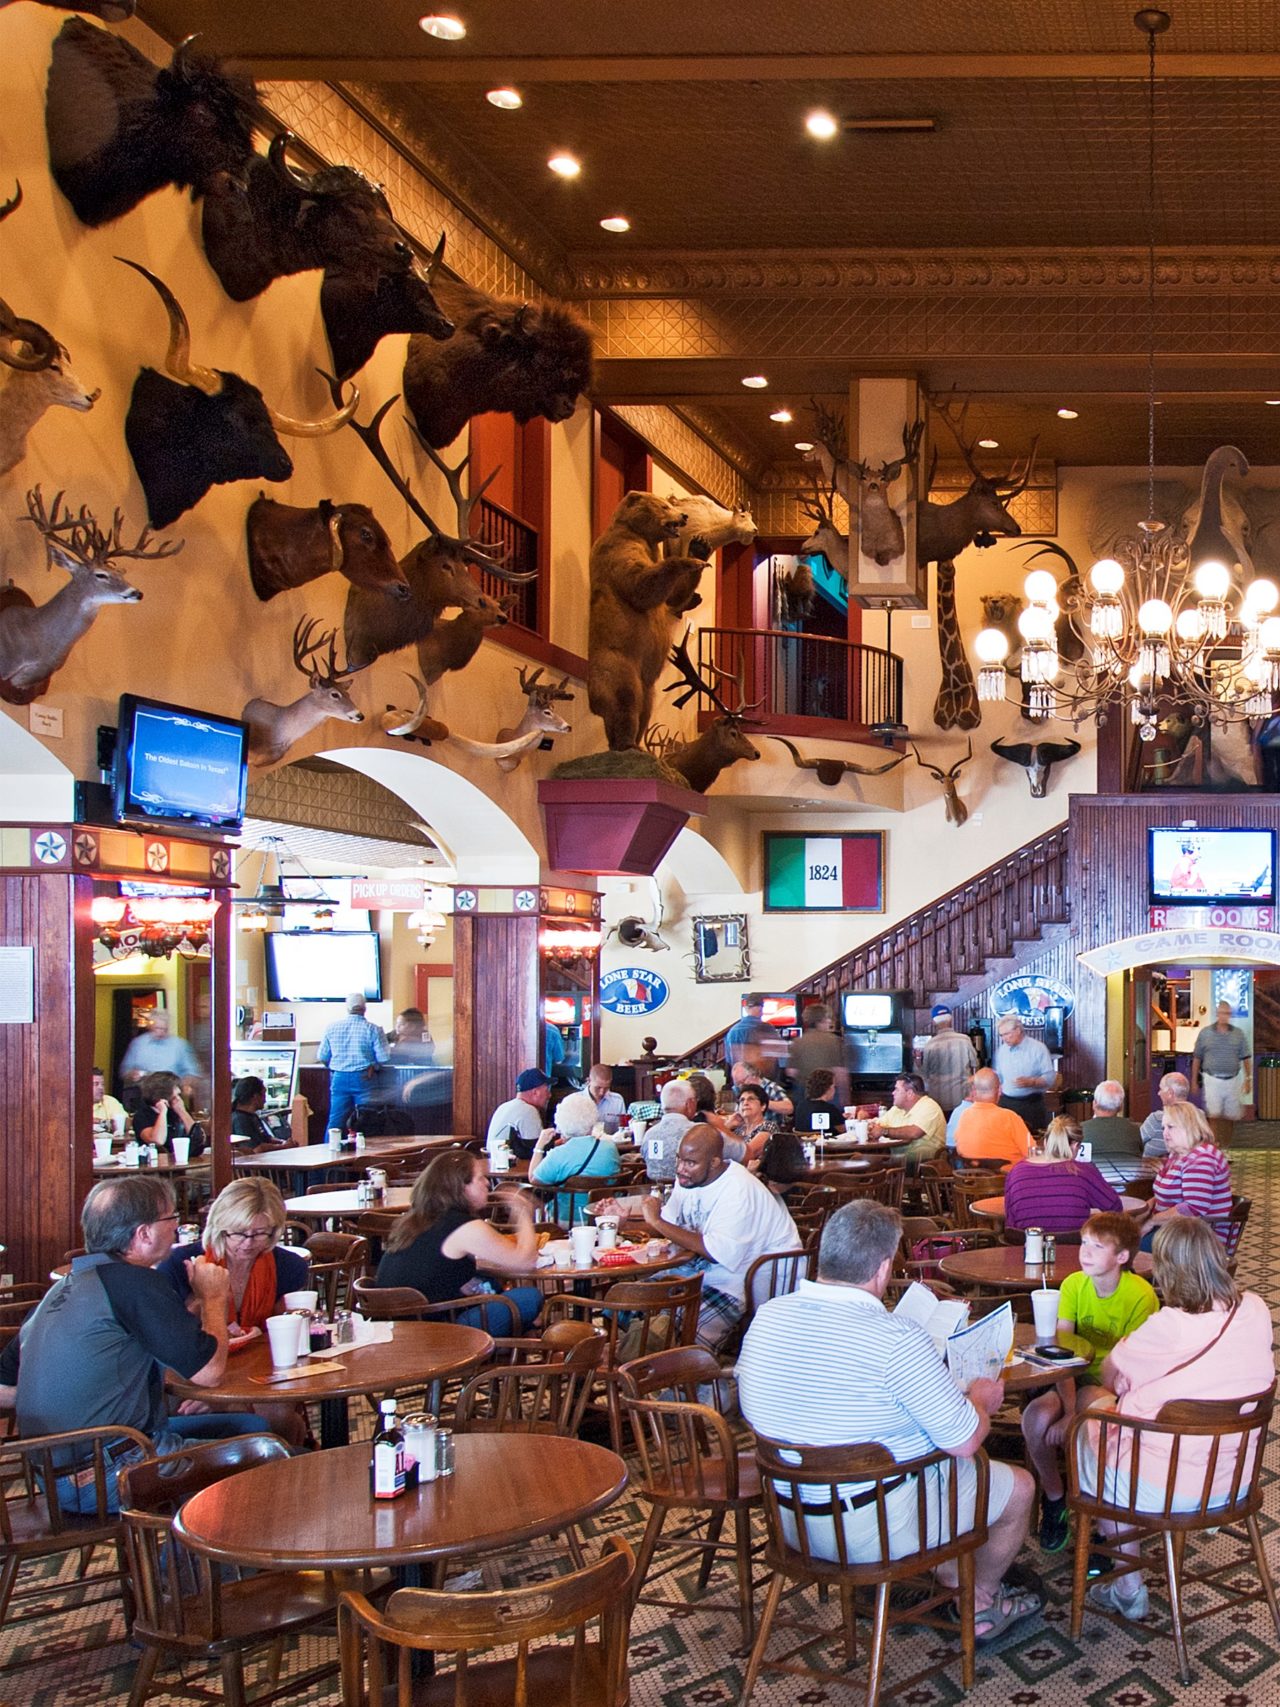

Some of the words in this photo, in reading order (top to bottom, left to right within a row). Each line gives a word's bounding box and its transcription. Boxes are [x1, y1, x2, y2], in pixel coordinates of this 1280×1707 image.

[809, 865, 838, 880] 1824
[391, 883, 421, 898] ORDERS
[1154, 909, 1270, 926] RESTROOMS
[1135, 932, 1208, 952] GAME
[600, 970, 628, 989] LONE
[632, 970, 662, 989] STAR
[997, 978, 1031, 998] LONE
[1035, 978, 1071, 998] STAR
[616, 1003, 648, 1014] BEER
[818, 1115, 823, 1124] 5
[653, 1141, 658, 1154] 8
[1080, 1145, 1085, 1157] 2
